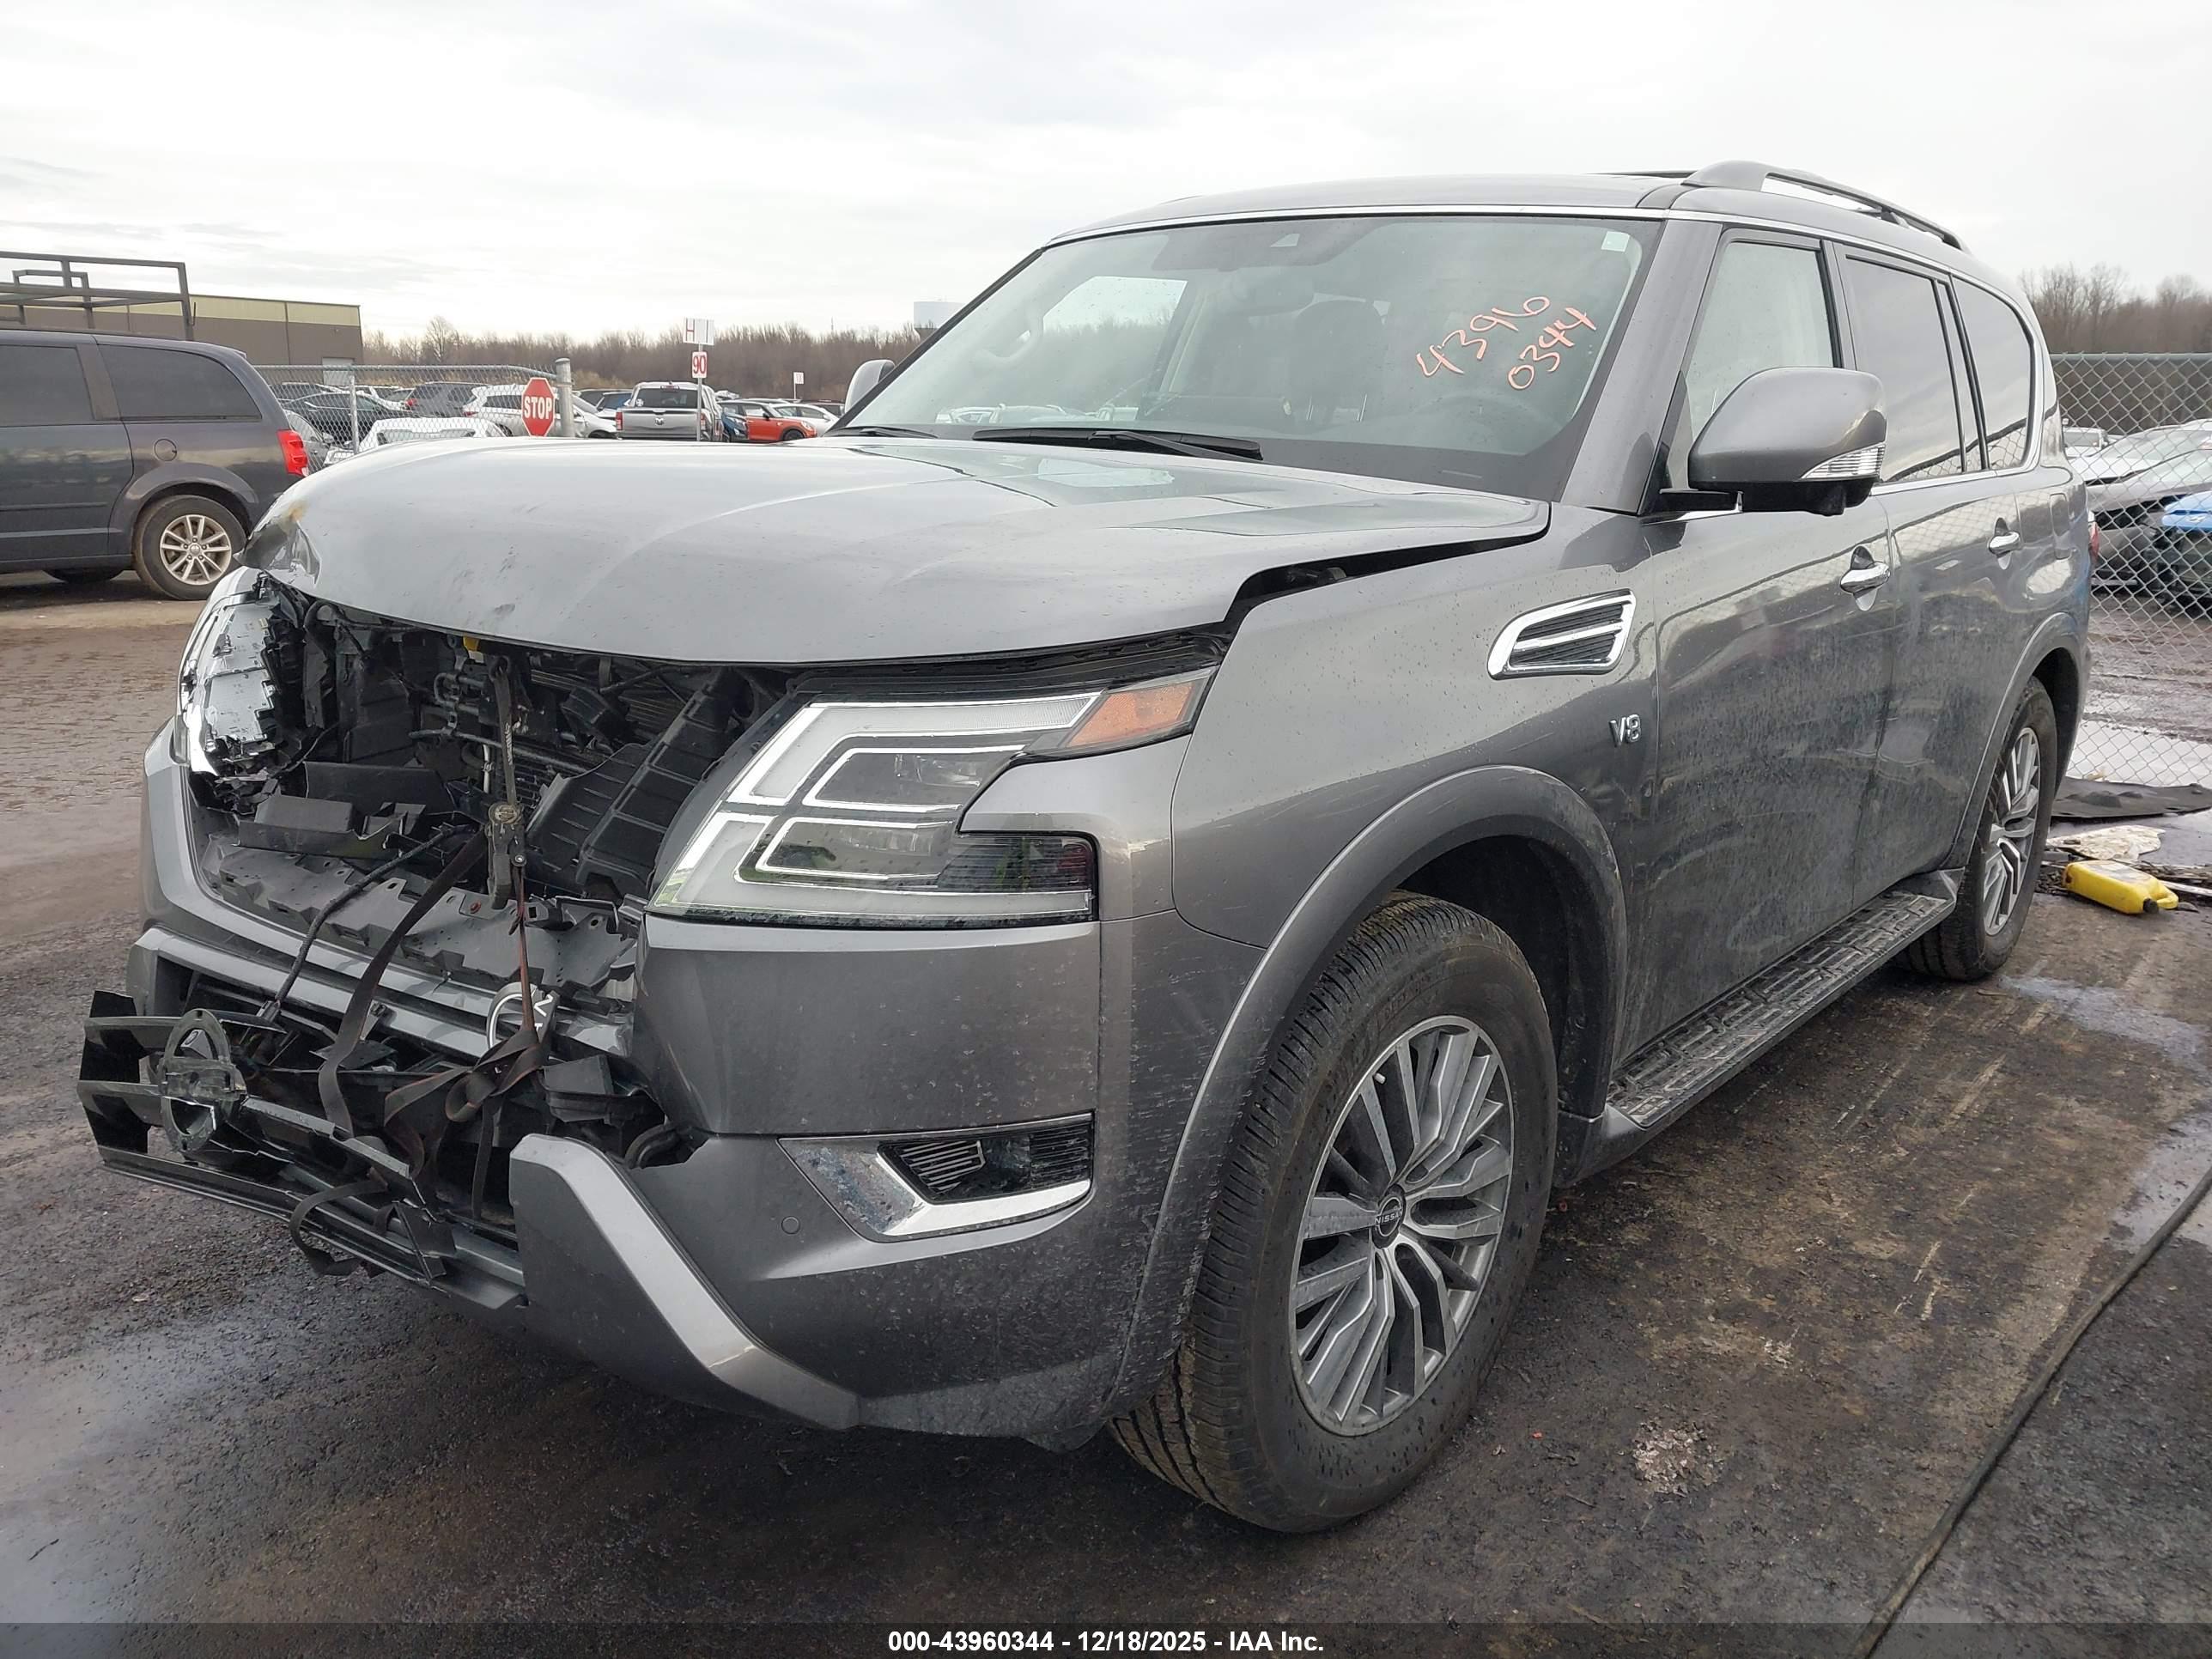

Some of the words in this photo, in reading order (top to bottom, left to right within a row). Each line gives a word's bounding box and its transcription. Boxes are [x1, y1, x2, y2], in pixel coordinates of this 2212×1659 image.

[1416, 295, 1551, 376] 4396
[1508, 307, 1597, 390] 0344
[692, 355, 707, 374] 90
[524, 396, 552, 420] STOP
[1608, 714, 1642, 748] V8
